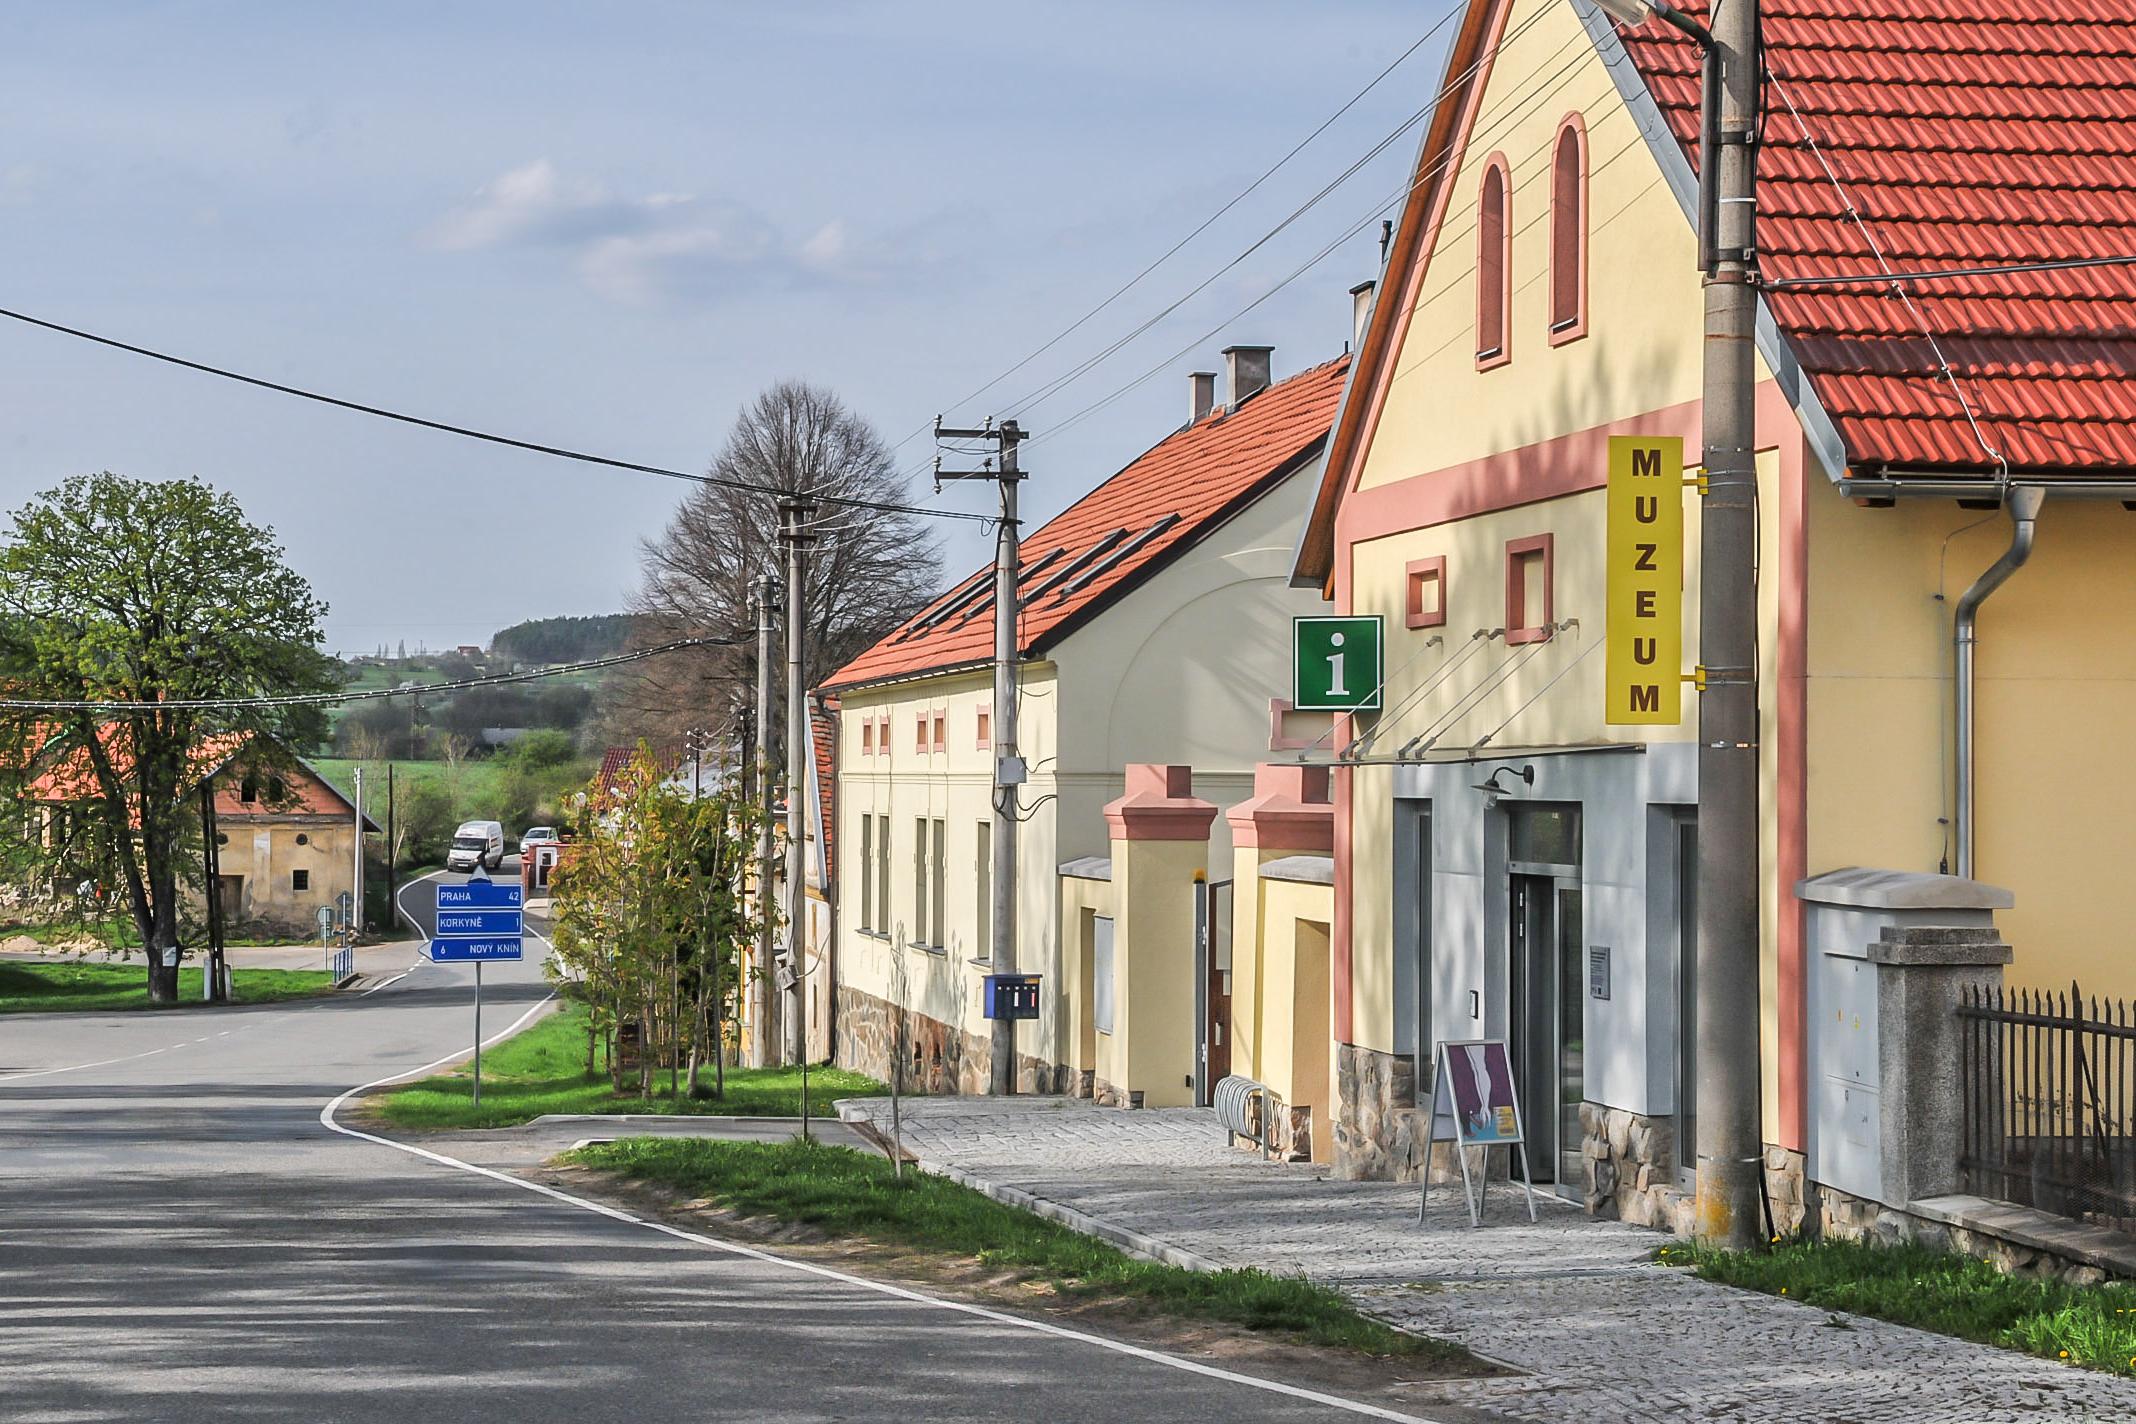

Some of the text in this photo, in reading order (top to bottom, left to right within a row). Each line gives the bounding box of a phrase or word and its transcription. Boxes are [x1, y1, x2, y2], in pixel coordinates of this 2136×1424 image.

[1630, 448, 1661, 712] MUZEUM
[440, 891, 519, 901] PRAHA 42
[440, 941, 519, 954] 6 NOVÝ KNÍN
